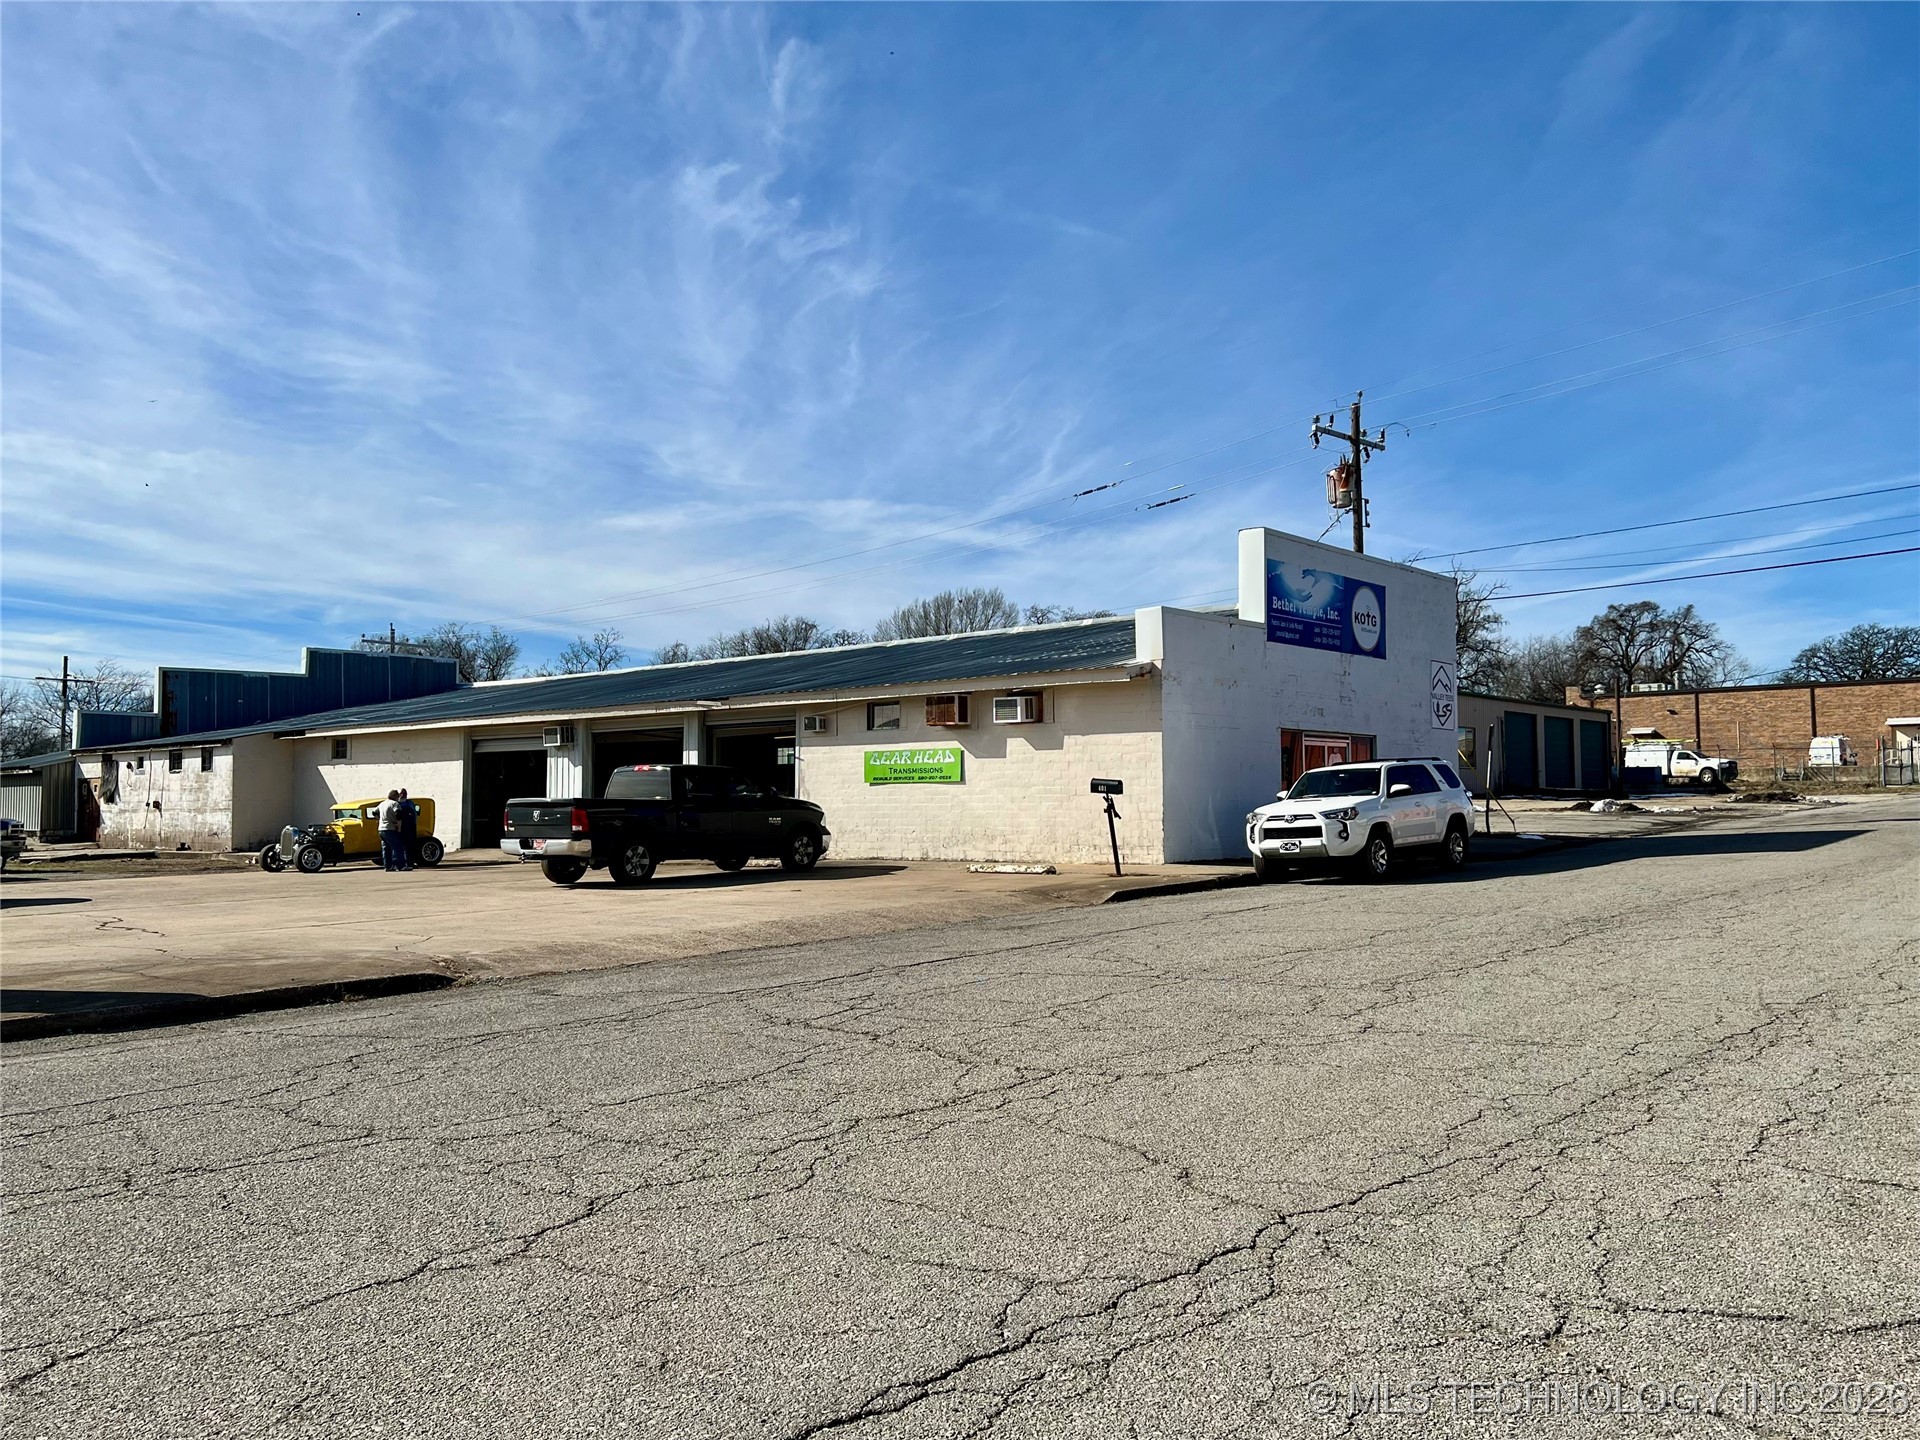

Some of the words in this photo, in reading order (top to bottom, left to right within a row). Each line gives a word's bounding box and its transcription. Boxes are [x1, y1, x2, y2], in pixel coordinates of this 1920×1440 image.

[1272, 596, 1296, 612] Bethel
[1327, 607, 1341, 620] Inc.
[869, 752, 911, 765] GEAR
[913, 750, 955, 763] HEAD
